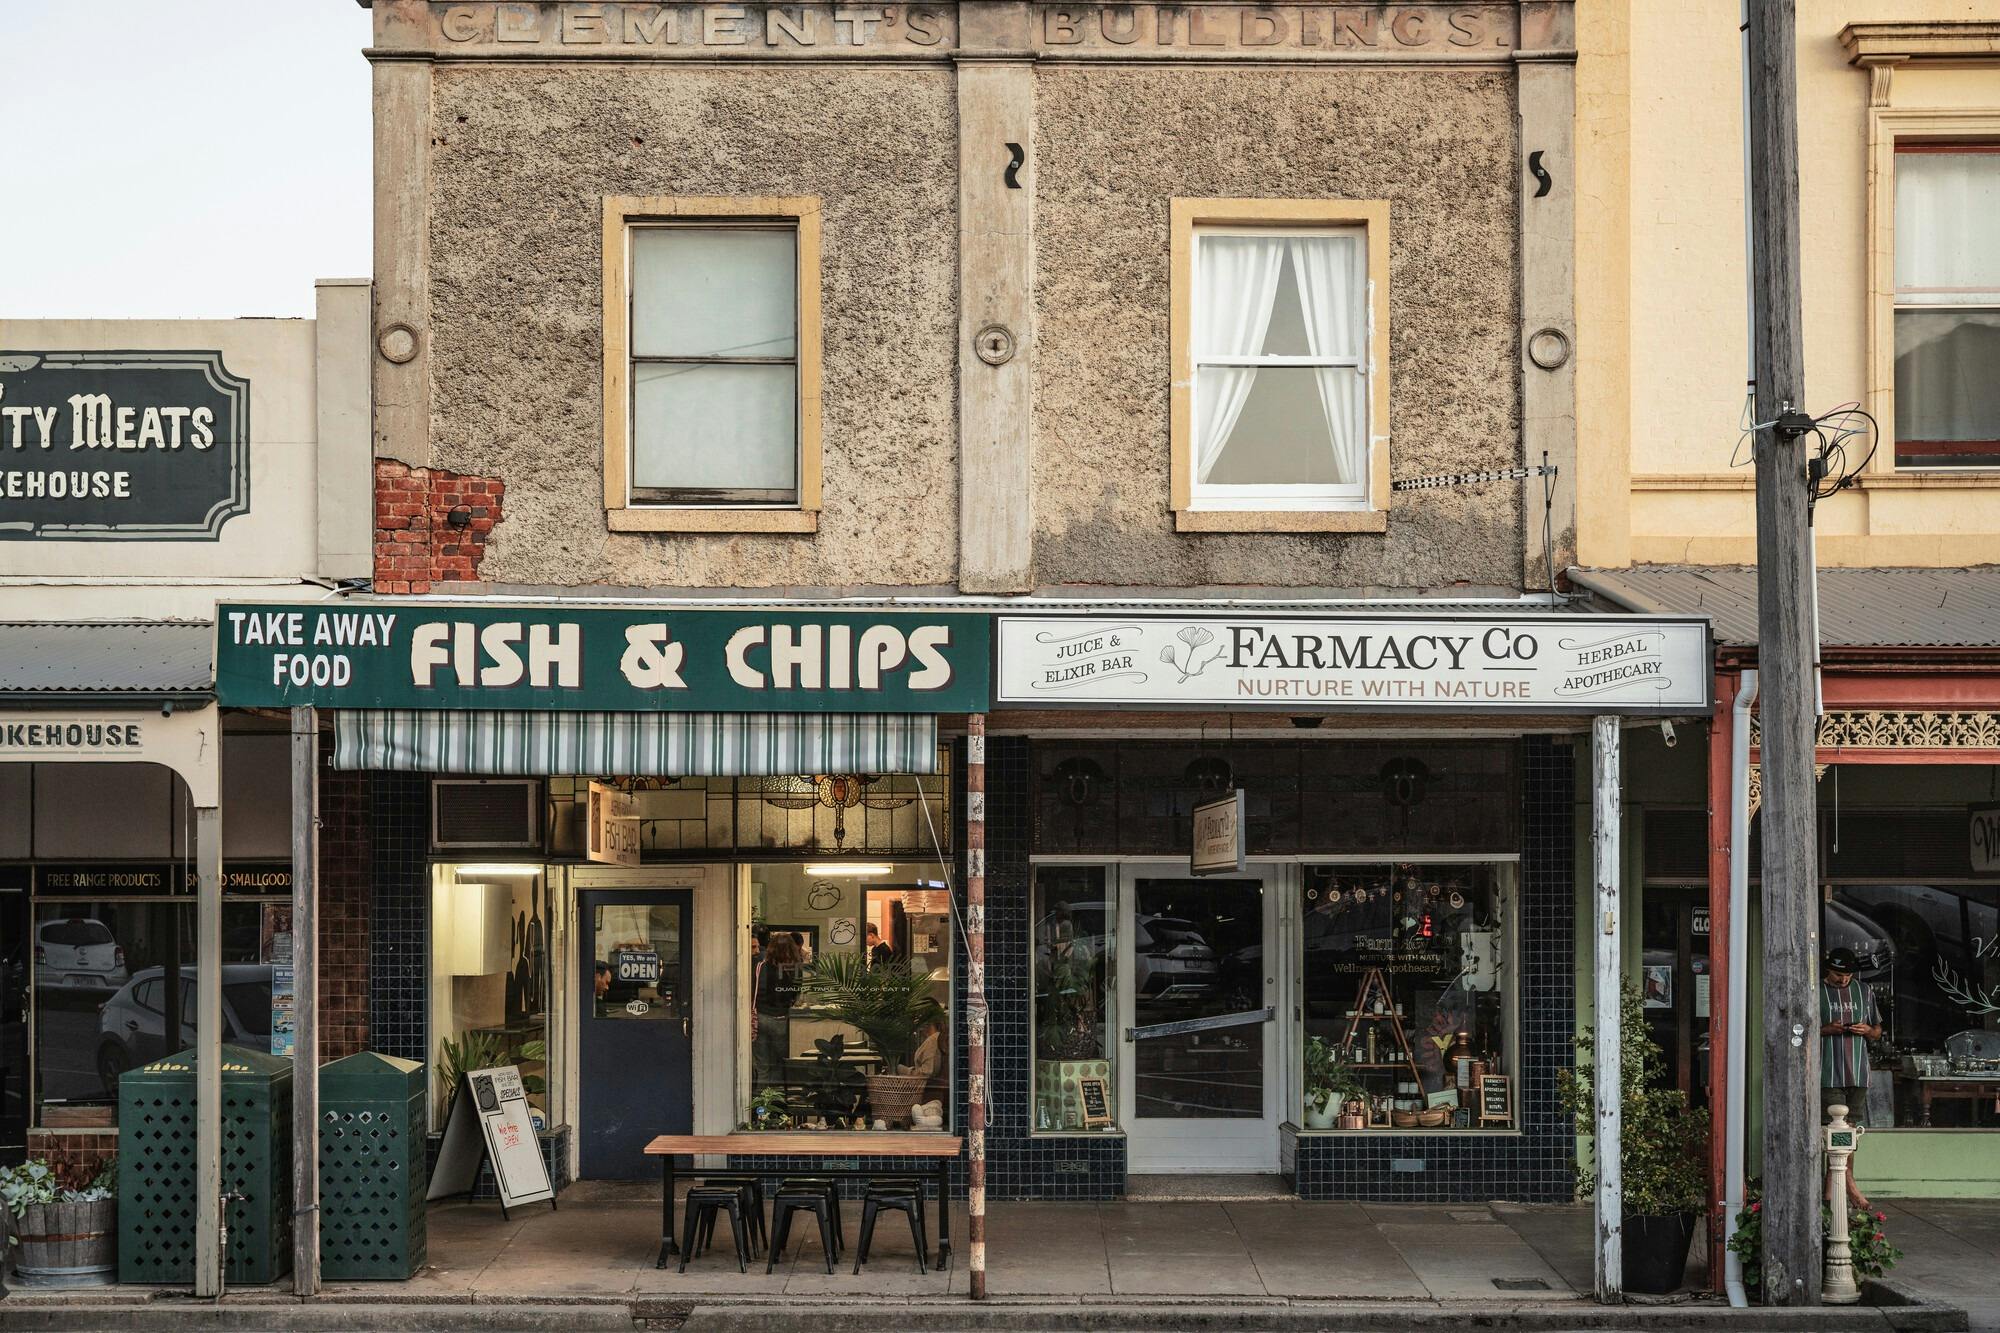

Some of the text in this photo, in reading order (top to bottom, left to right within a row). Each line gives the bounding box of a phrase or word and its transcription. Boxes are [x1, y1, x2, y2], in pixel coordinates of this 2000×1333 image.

[439, 6, 943, 46] CLEMENT'S
[0, 393, 214, 450] TY MEATS
[228, 612, 396, 646] TAKE AWAY
[410, 621, 951, 689] FISH & CHIPS
[1056, 634, 1121, 659] JUICE &
[1225, 626, 1474, 670] FARMACY
[1577, 639, 1647, 666] HERBAL
[273, 653, 351, 687] FOOD
[1045, 656, 1133, 684] ELIXIR BAR
[1563, 661, 1663, 690] APOTHECARY
[1237, 679, 1531, 698] NURTURE WITH NATURE
[0, 724, 140, 746] KEHOUSE
[47, 873, 161, 887] FREE RANGE PRODUCTS
[230, 873, 292, 887] SMALLGOOD
[1694, 917, 1710, 932] CLO
[621, 963, 656, 978] OPEN
